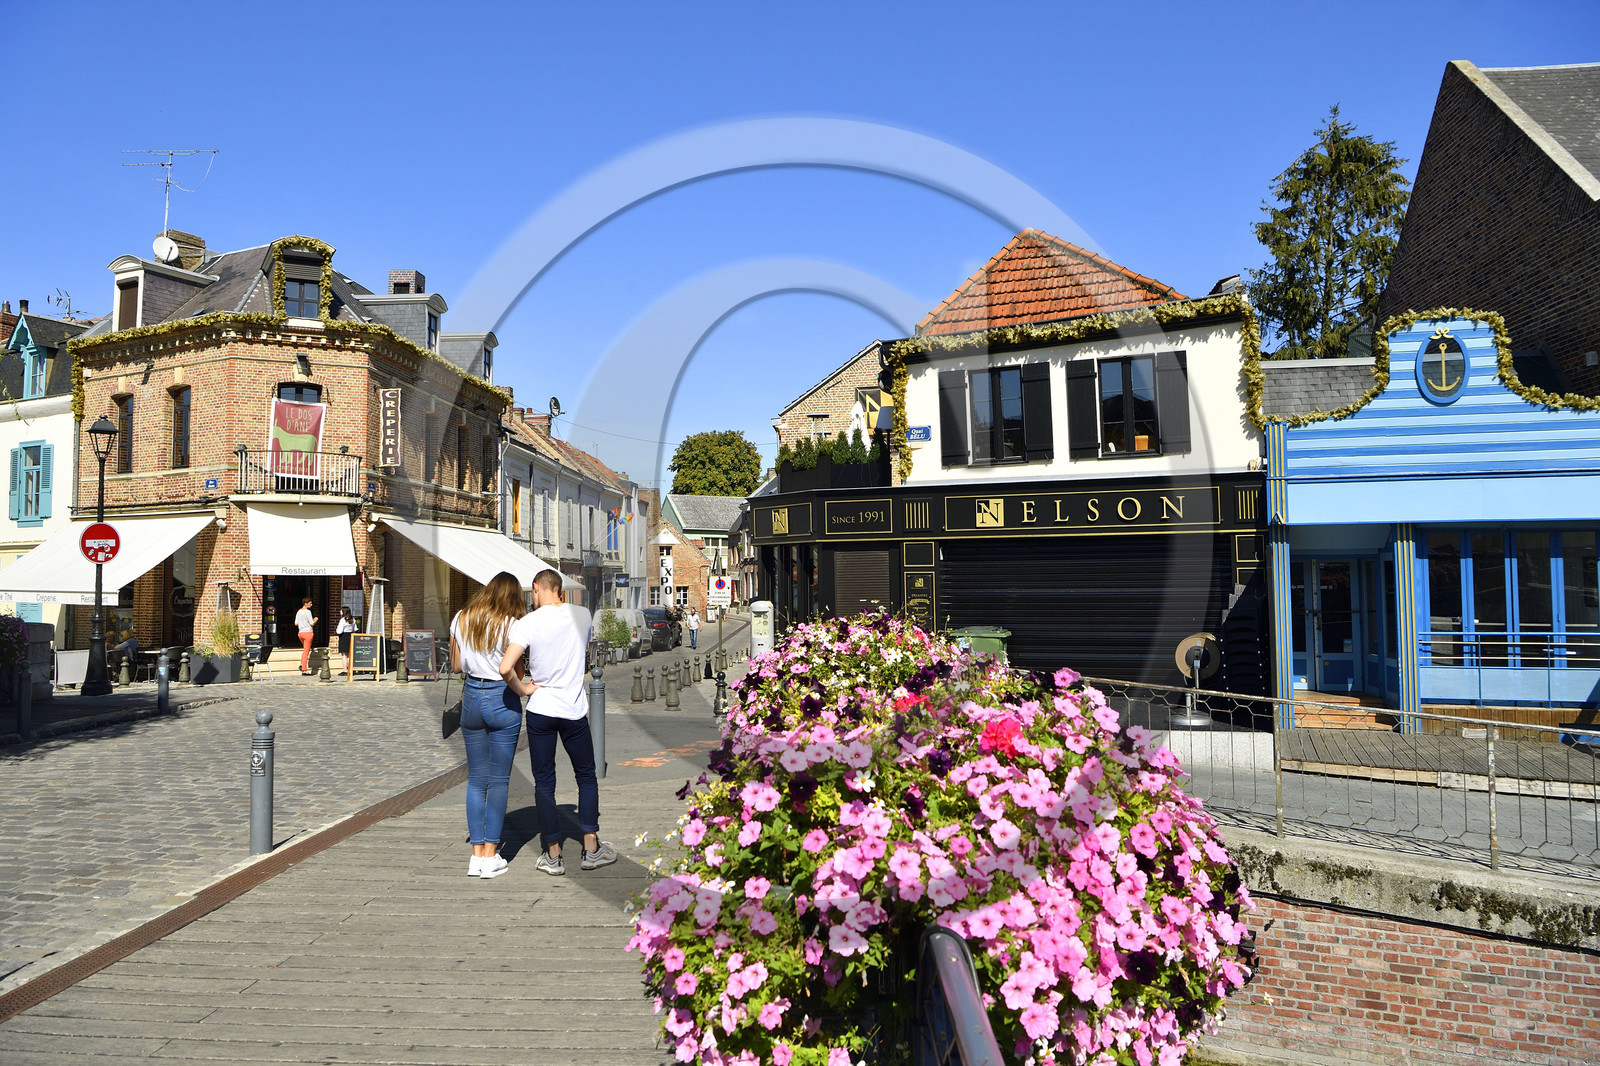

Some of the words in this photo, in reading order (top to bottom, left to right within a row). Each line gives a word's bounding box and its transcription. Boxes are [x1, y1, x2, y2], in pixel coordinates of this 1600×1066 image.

[286, 407, 294, 419] LE
[298, 408, 313, 421] DOS
[286, 418, 310, 433] D'ÂNE
[385, 390, 398, 465] CREPERIE
[859, 510, 885, 524] 1991
[978, 495, 1186, 525] NELSON
[281, 566, 327, 575] Restaurant
[660, 558, 673, 595] EXPO
